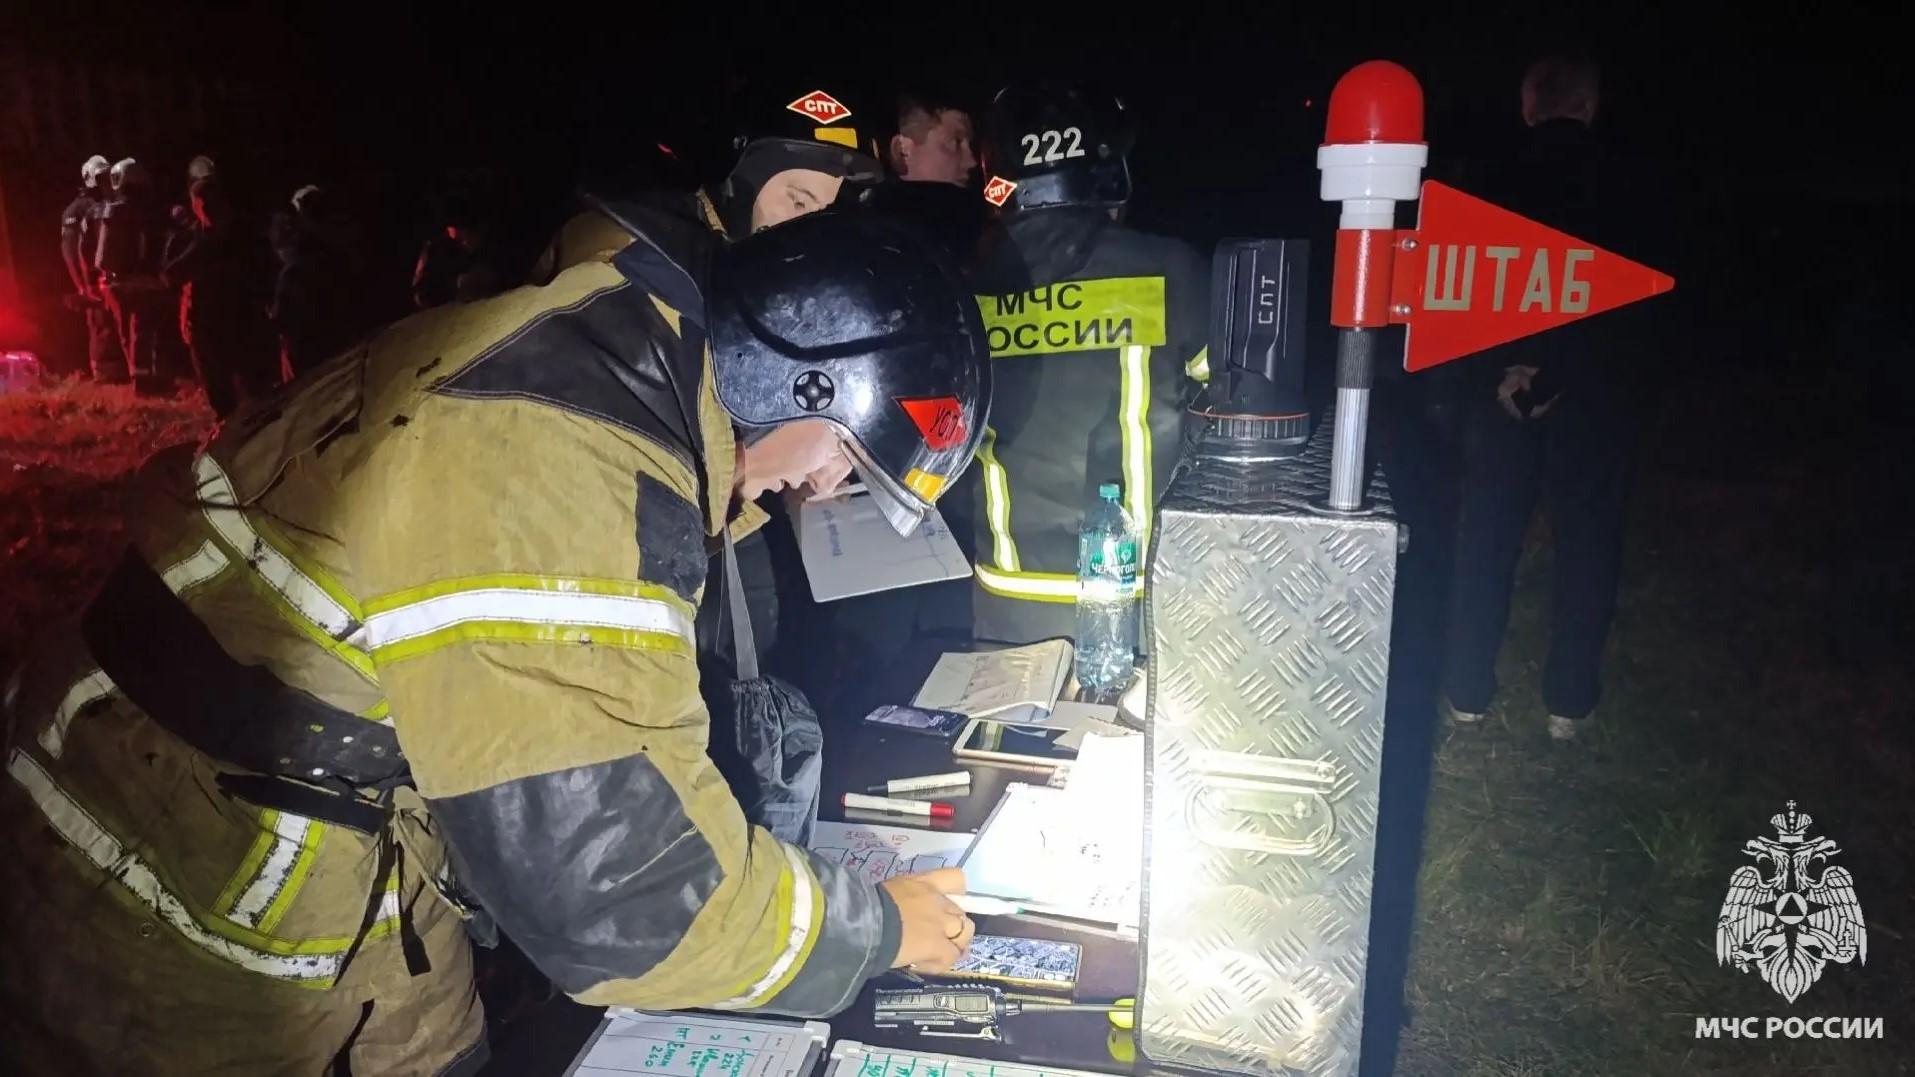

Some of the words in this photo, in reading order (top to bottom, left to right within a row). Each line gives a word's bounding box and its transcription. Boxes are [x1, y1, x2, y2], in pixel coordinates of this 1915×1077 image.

[804, 98, 838, 115] СПТ
[1020, 126, 1086, 167] 222
[1422, 244, 1596, 314] ШТАБ
[995, 283, 1083, 317] МЧС
[1257, 274, 1276, 325] СПТ
[986, 317, 1133, 352] ОССИИ
